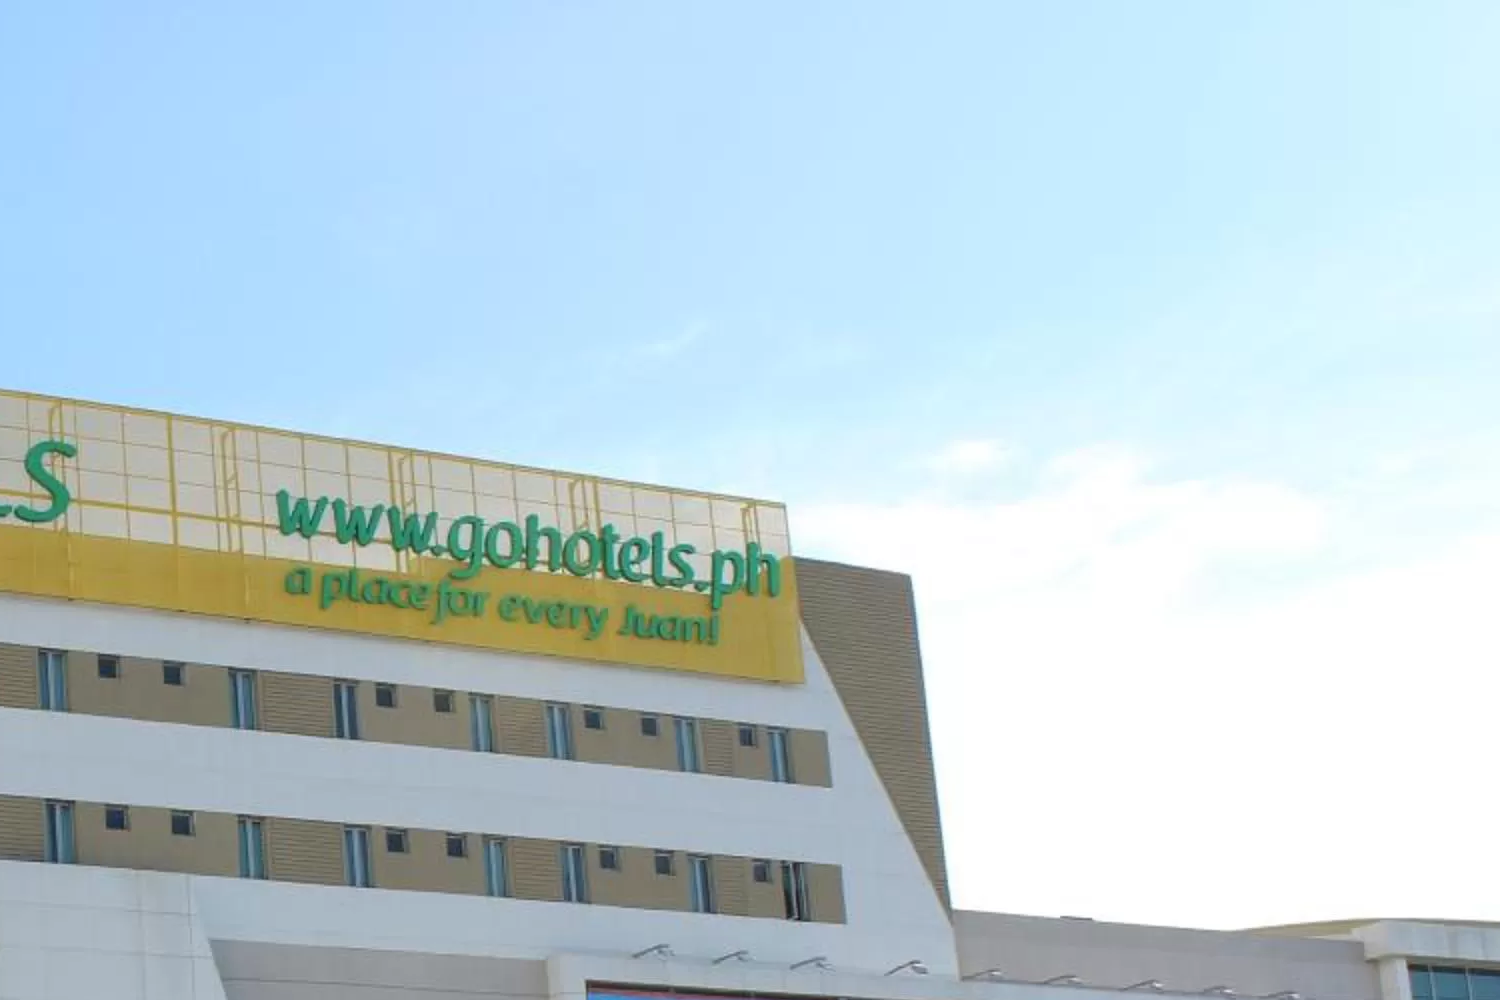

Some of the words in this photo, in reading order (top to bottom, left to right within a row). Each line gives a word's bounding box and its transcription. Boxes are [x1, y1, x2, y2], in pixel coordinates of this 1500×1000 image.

[275, 489, 780, 608] www.gohotels.ph
[285, 567, 310, 595] a
[321, 567, 430, 610] place
[430, 579, 490, 626] for
[497, 593, 609, 642] every
